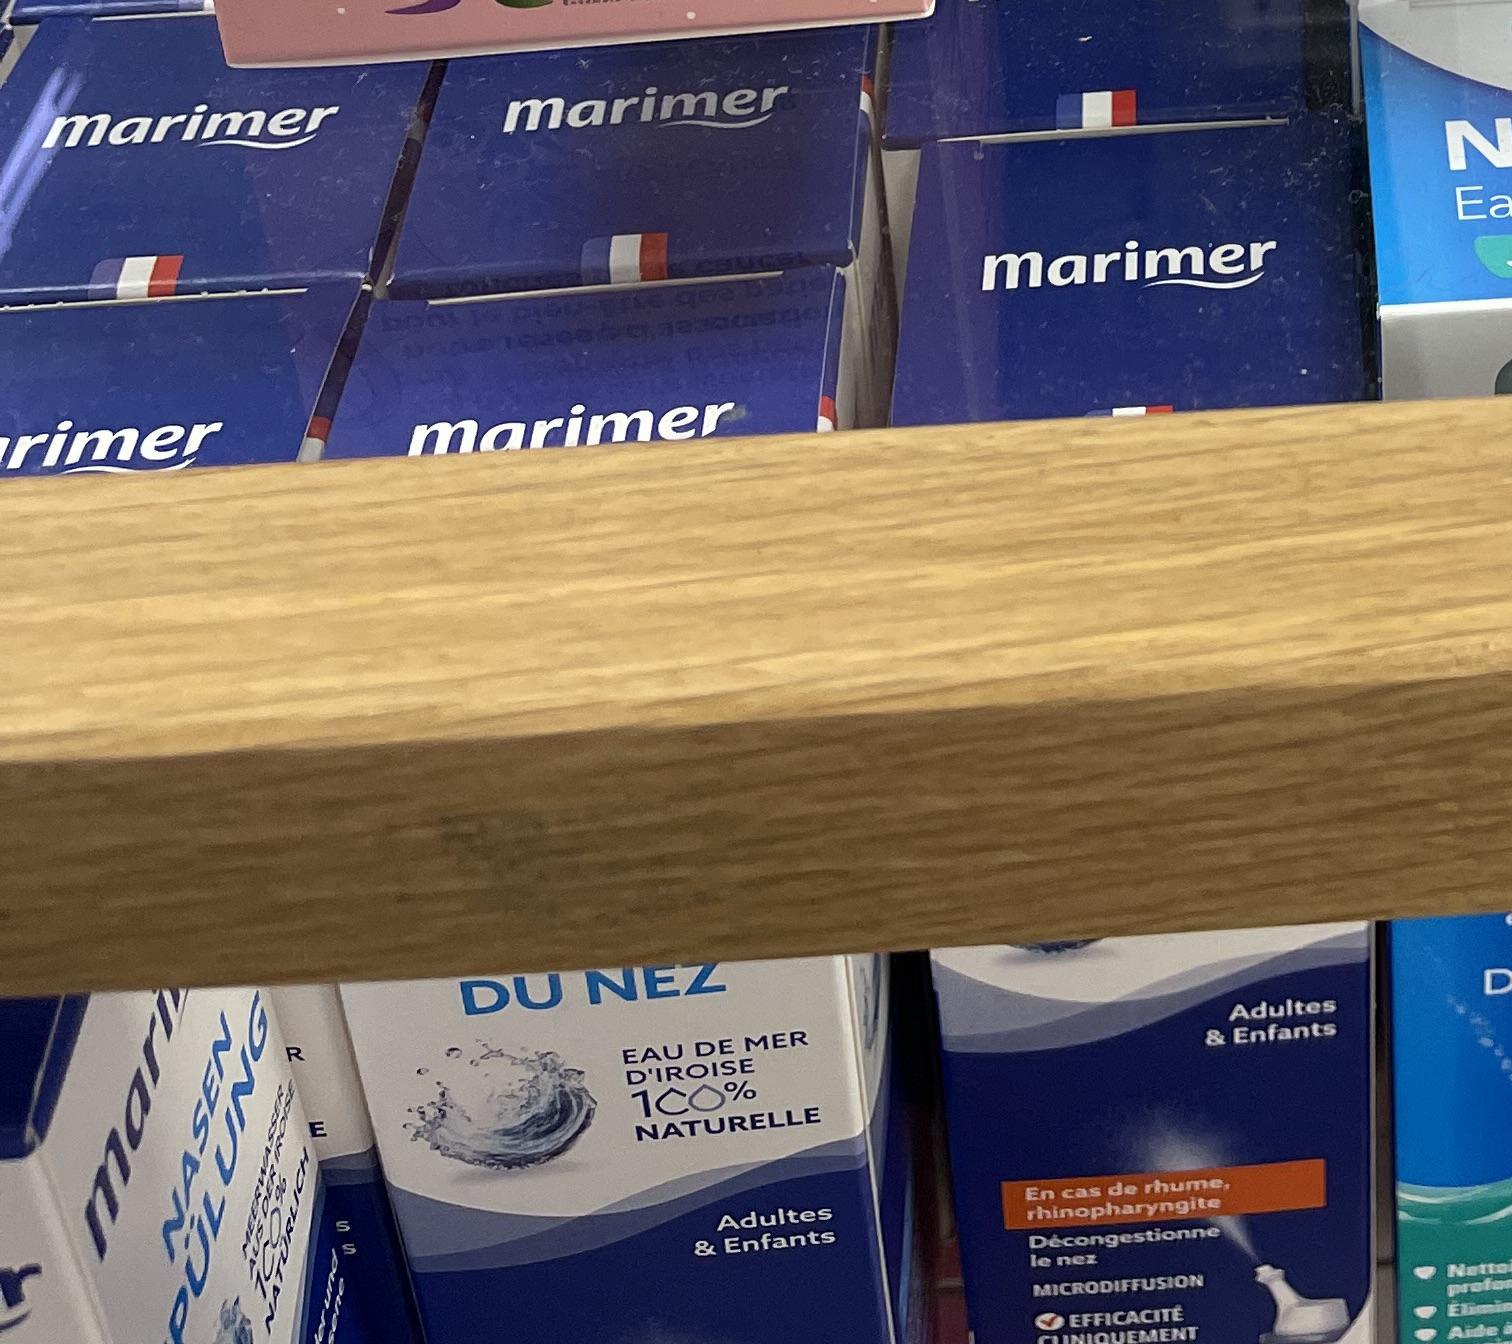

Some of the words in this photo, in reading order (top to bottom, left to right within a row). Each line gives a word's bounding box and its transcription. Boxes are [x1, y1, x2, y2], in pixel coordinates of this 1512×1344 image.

[502, 85, 789, 134] marimer
[41, 104, 340, 150] marimer
[981, 239, 1277, 292] marimer
[407, 401, 736, 458] marimer
[459, 972, 564, 1016] DU
[585, 963, 727, 1006] NEZ
[1228, 998, 1338, 1022] Adultes
[622, 1044, 684, 1065] EAU
[694, 1040, 734, 1058] DE
[744, 1030, 809, 1051] MER
[1204, 1029, 1227, 1047] &
[1232, 1021, 1338, 1044] Enfants
[625, 1057, 756, 1086] D'IROISE
[631, 1080, 757, 1119] 100%
[162, 1009, 232, 1263] NASEN
[634, 1106, 822, 1142] NATURELLE
[1024, 1186, 1055, 1201] En
[1060, 1185, 1102, 1200] cas
[1112, 1181, 1139, 1197] de
[1144, 1176, 1231, 1195] rhume,
[716, 1207, 833, 1231] Adultes
[1026, 1196, 1222, 1221] rhinopharyngite
[693, 1239, 717, 1256] &
[723, 1228, 836, 1254] Enfants
[1028, 1224, 1222, 1251] Décongestionne
[1030, 1254, 1052, 1268] le
[1056, 1253, 1099, 1267] nez
[1032, 1274, 1205, 1298] MICRODIFFUSION
[1068, 1305, 1185, 1329] EFFICACITÉ
